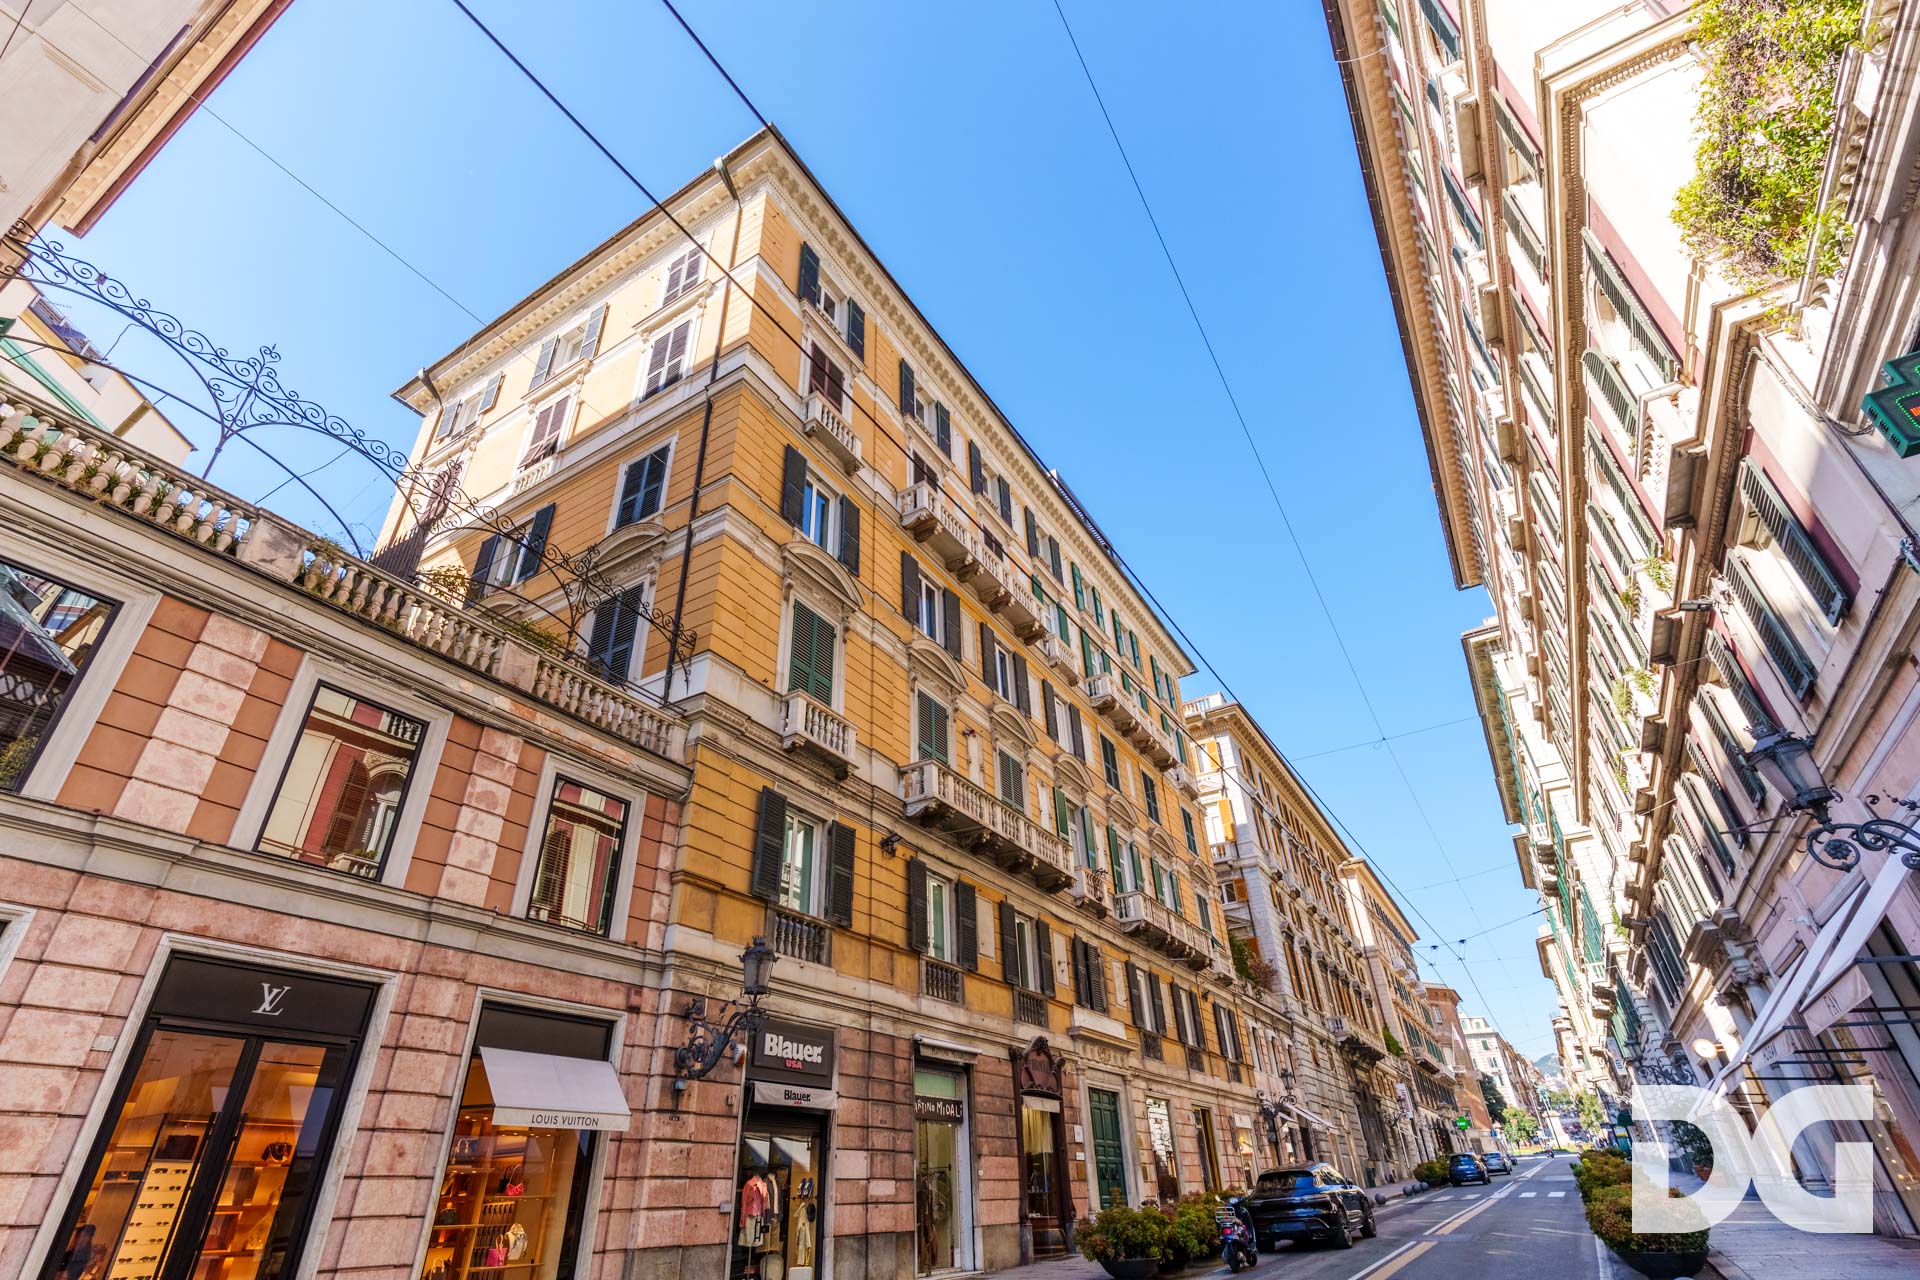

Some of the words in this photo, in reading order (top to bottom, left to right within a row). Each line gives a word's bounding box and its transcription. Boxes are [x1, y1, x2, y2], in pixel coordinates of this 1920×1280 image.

[785, 1059, 803, 1069] USA
[531, 1114, 559, 1125] LOUIS
[561, 1116, 600, 1127] VUITTON
